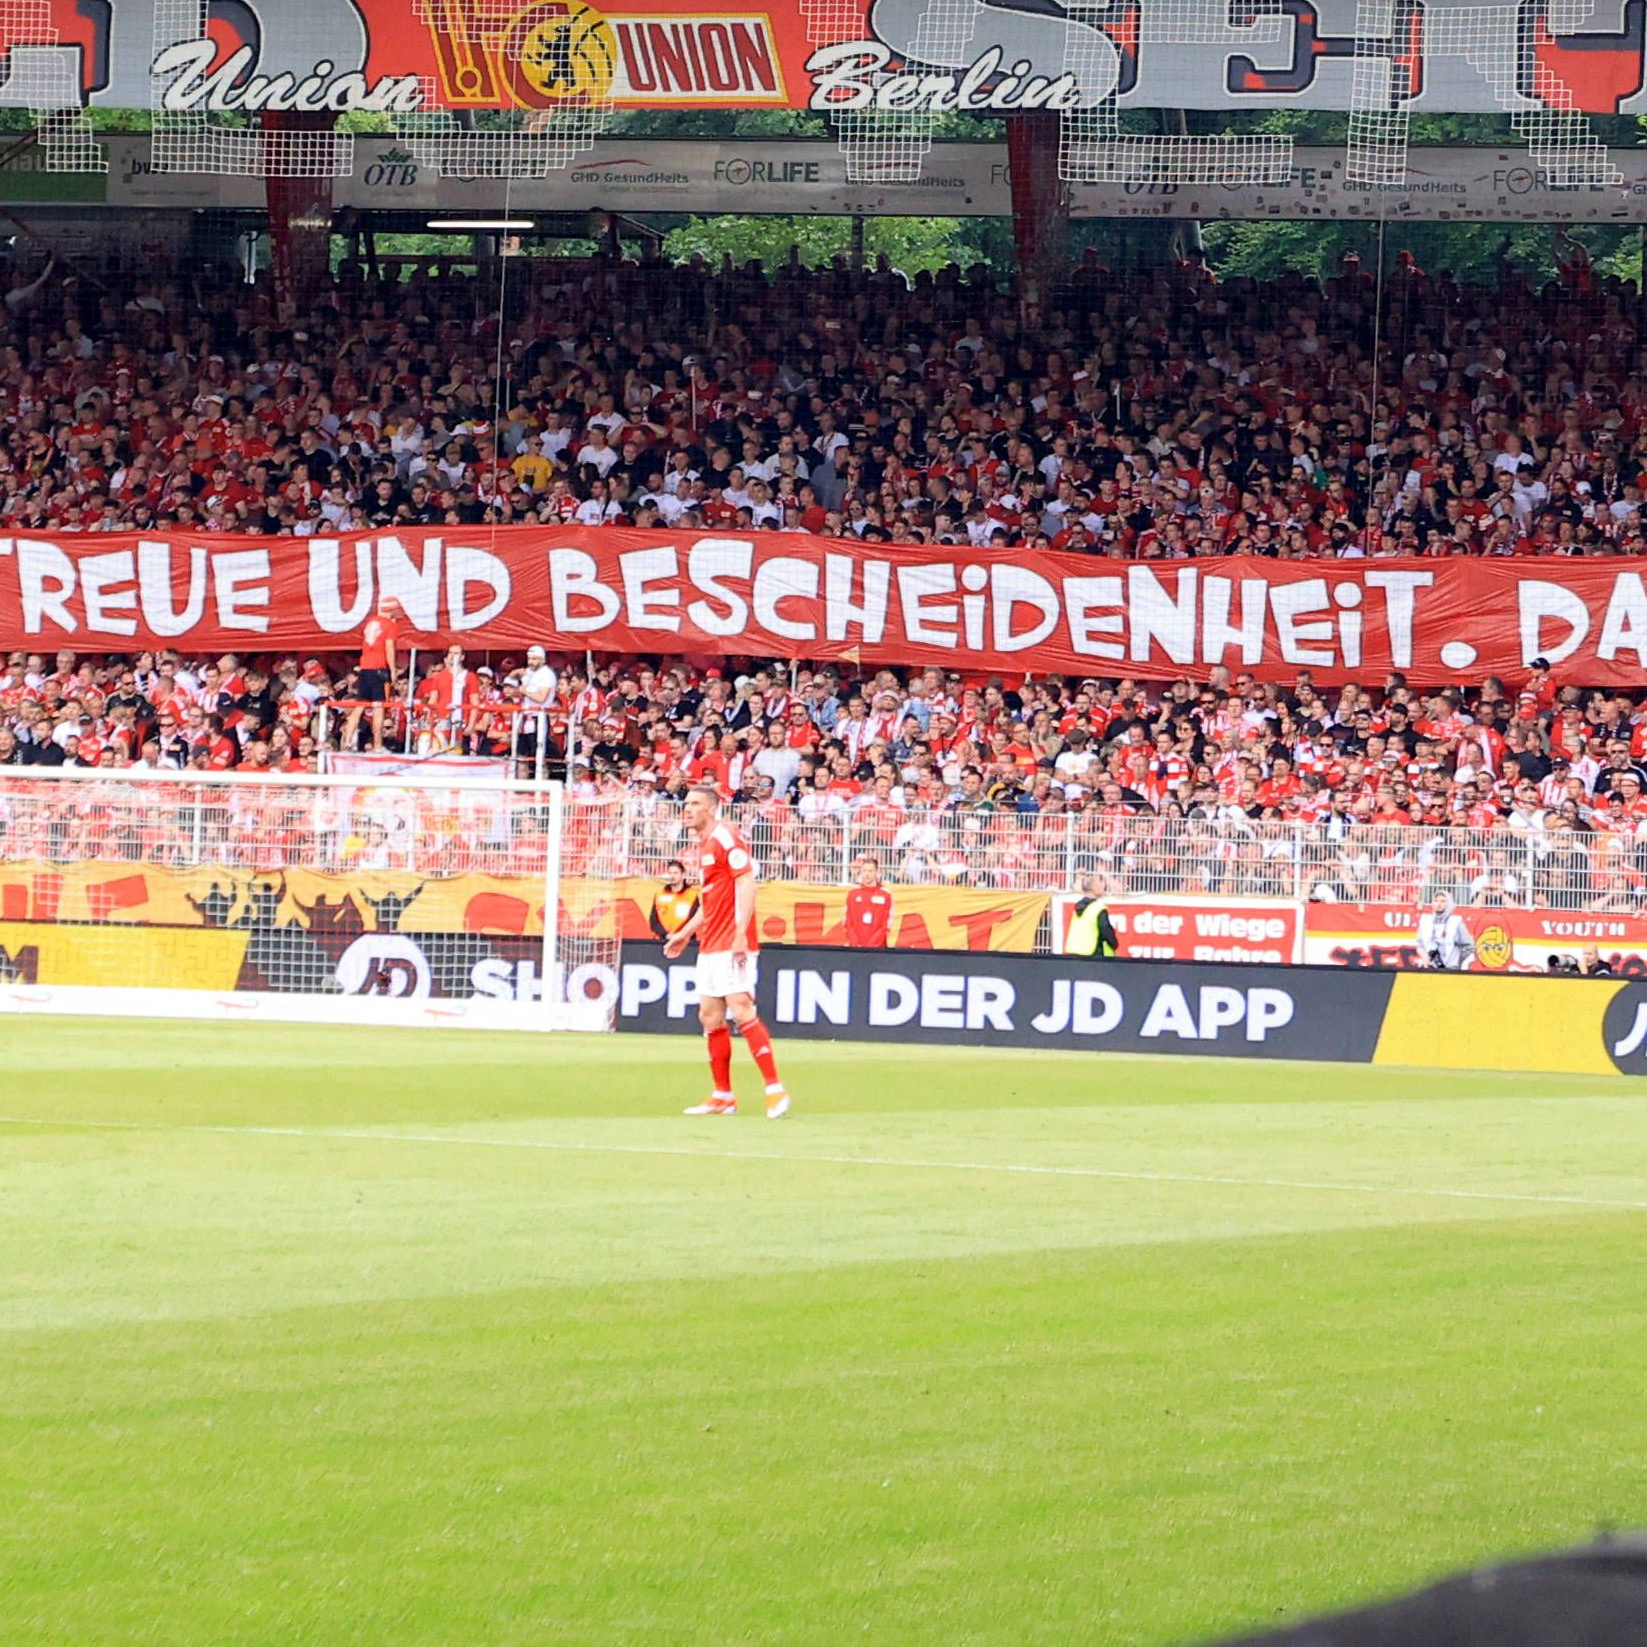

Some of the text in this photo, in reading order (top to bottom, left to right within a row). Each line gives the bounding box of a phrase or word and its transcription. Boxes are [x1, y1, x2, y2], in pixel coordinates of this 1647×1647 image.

[617, 21, 777, 95] UNION
[153, 39, 1081, 112] Union Berlin
[363, 163, 418, 187] OTB
[571, 172, 599, 184] GHD
[714, 158, 820, 185] FORLIFE
[307, 537, 512, 632] UND
[1133, 911, 1184, 935] der
[1194, 913, 1286, 942] Wiege
[1541, 919, 1627, 937] YOUTH
[776, 969, 851, 1026] IN
[868, 972, 1016, 1032] DER
[1030, 979, 1125, 1036] JD
[1140, 983, 1295, 1042] APP
